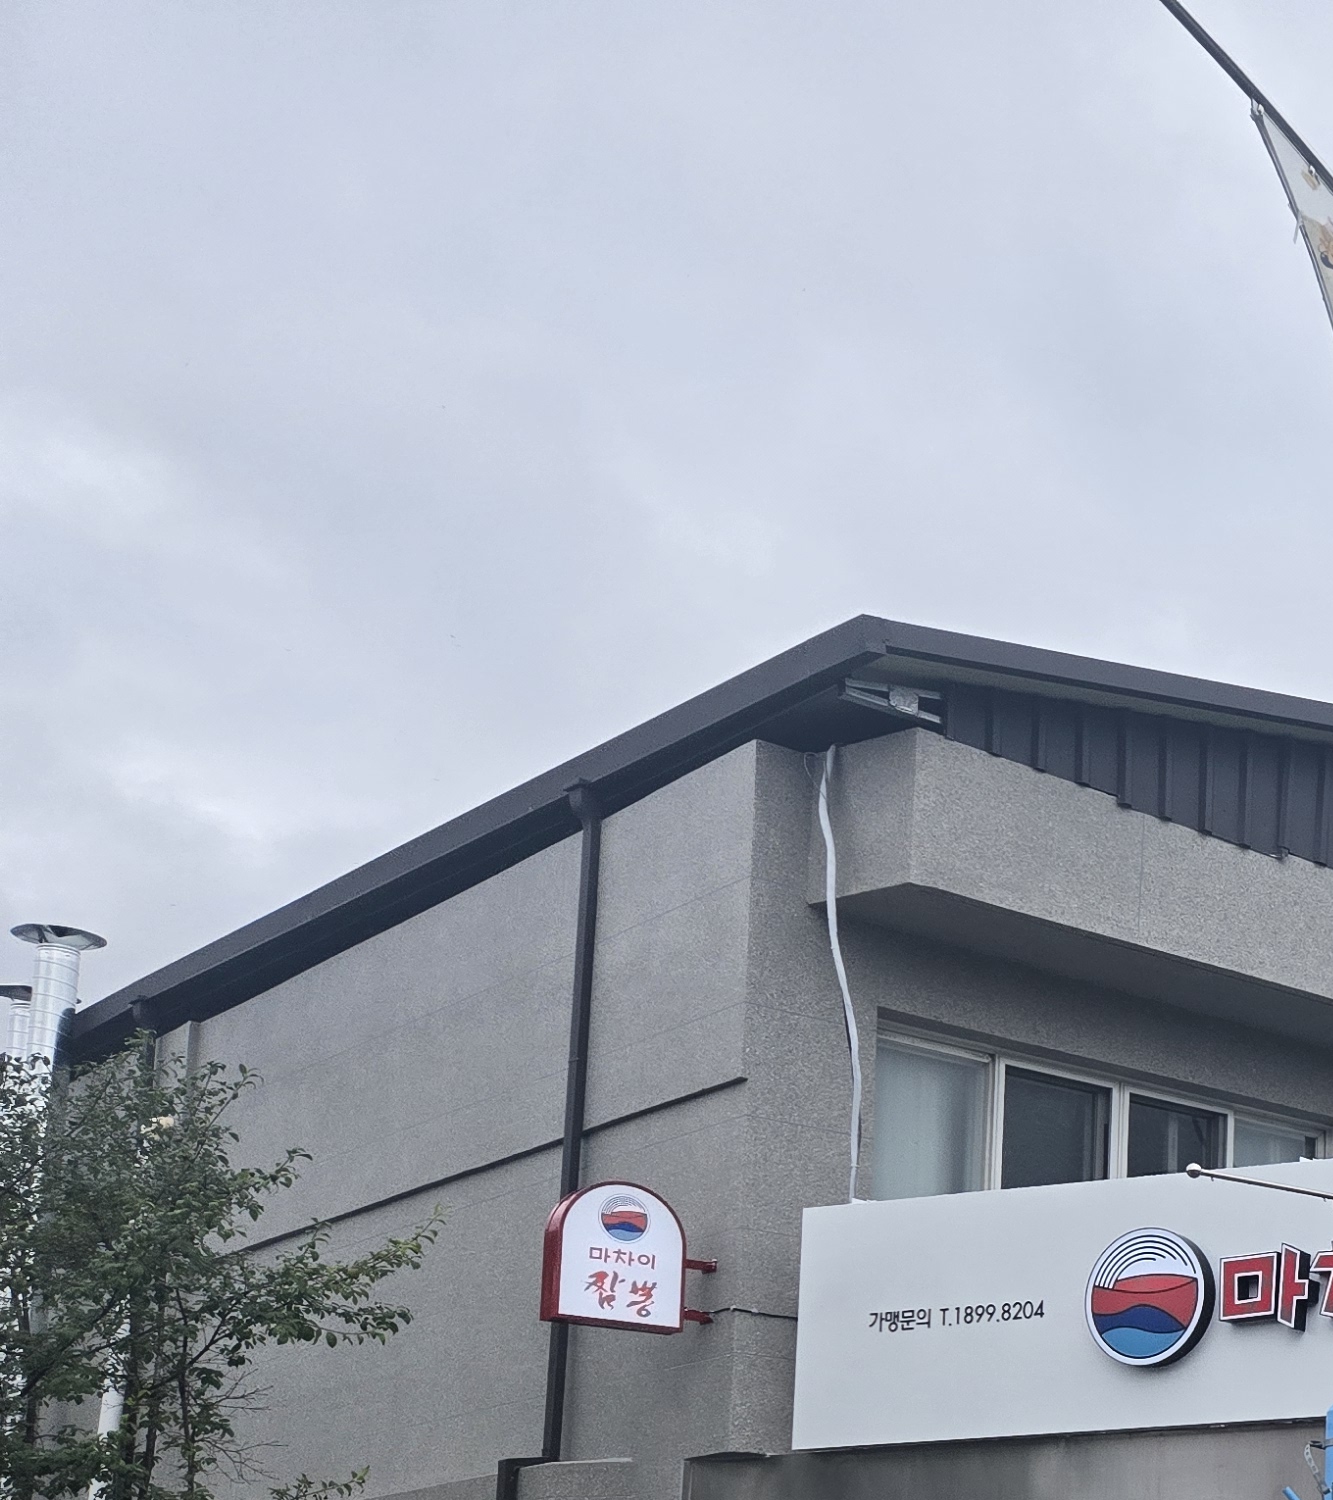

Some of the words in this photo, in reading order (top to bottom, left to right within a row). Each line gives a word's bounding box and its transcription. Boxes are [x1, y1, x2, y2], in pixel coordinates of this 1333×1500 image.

[588, 1246, 656, 1270] 마차이
[581, 1270, 658, 1318] 짬뽕
[868, 1308, 931, 1332] 가맹문의
[938, 1299, 1045, 1327] T.1899.8204
